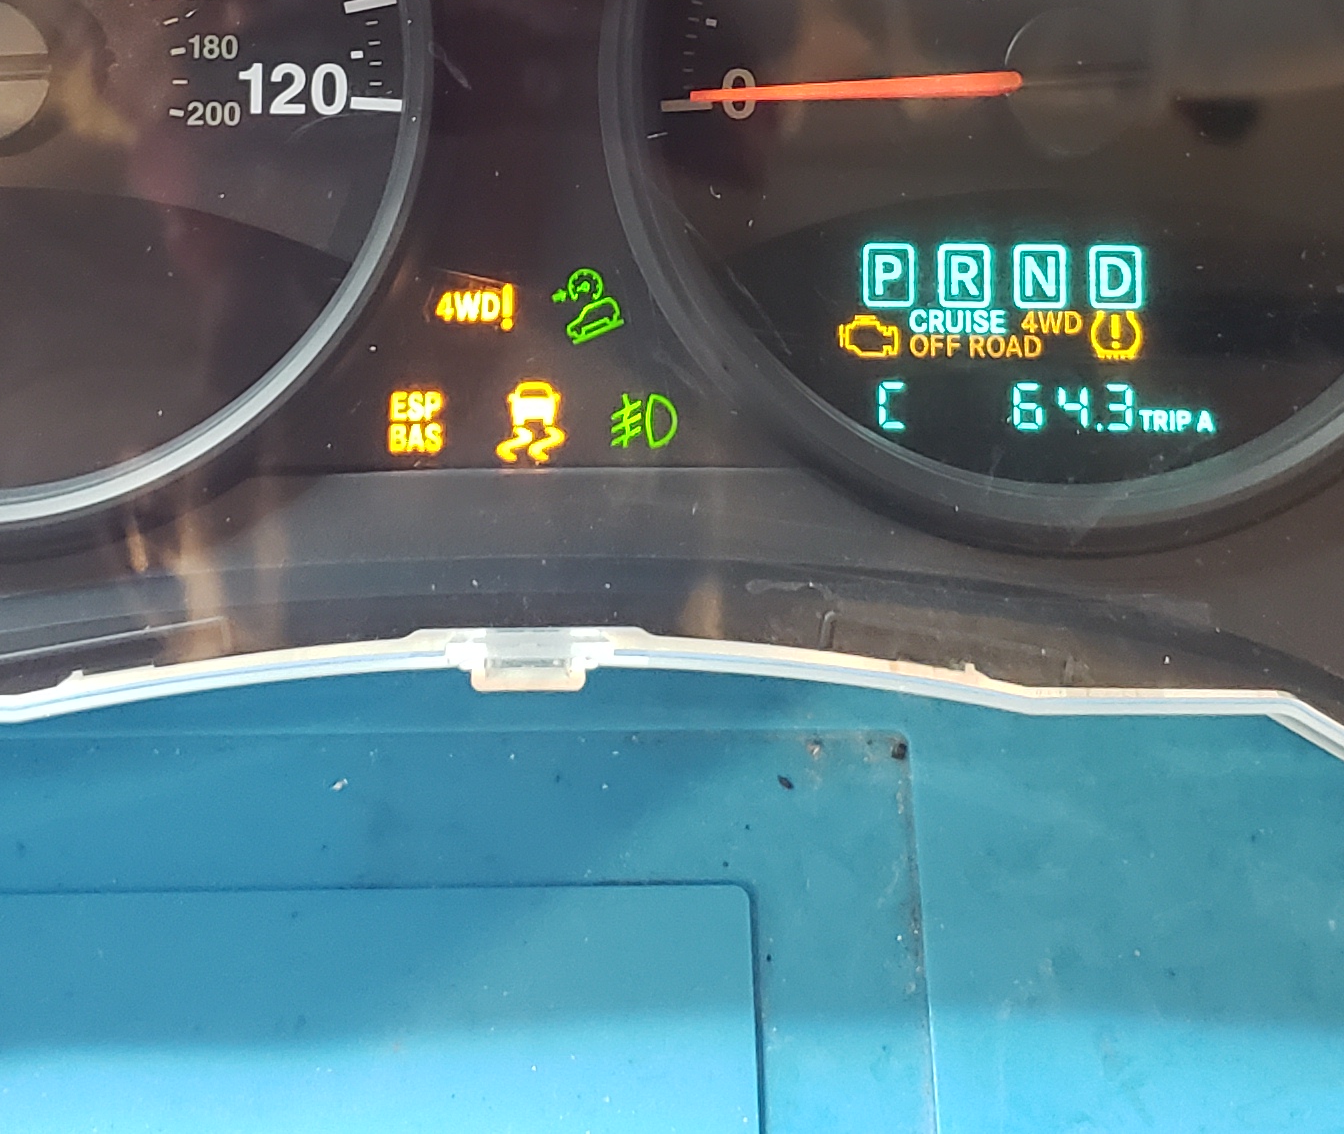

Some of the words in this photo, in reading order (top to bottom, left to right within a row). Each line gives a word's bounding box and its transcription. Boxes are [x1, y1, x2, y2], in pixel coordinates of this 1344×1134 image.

[187, 33, 239, 61] 180
[237, 61, 349, 116] 120
[721, 68, 757, 121] 0
[185, 100, 241, 127] 200
[873, 254, 903, 297] P
[949, 254, 980, 298] R
[1023, 255, 1057, 298] N
[1098, 256, 1133, 299] D
[908, 308, 1007, 336] CRUISE
[1020, 310, 1083, 336] 4WD
[908, 334, 960, 359] OFF
[968, 334, 1043, 359] ROAD
[388, 390, 445, 423] ESP
[1011, 381, 1135, 433] 64.3
[1138, 408, 1192, 434] TRIP
[1196, 410, 1216, 434] A
[387, 423, 445, 455] BAS
